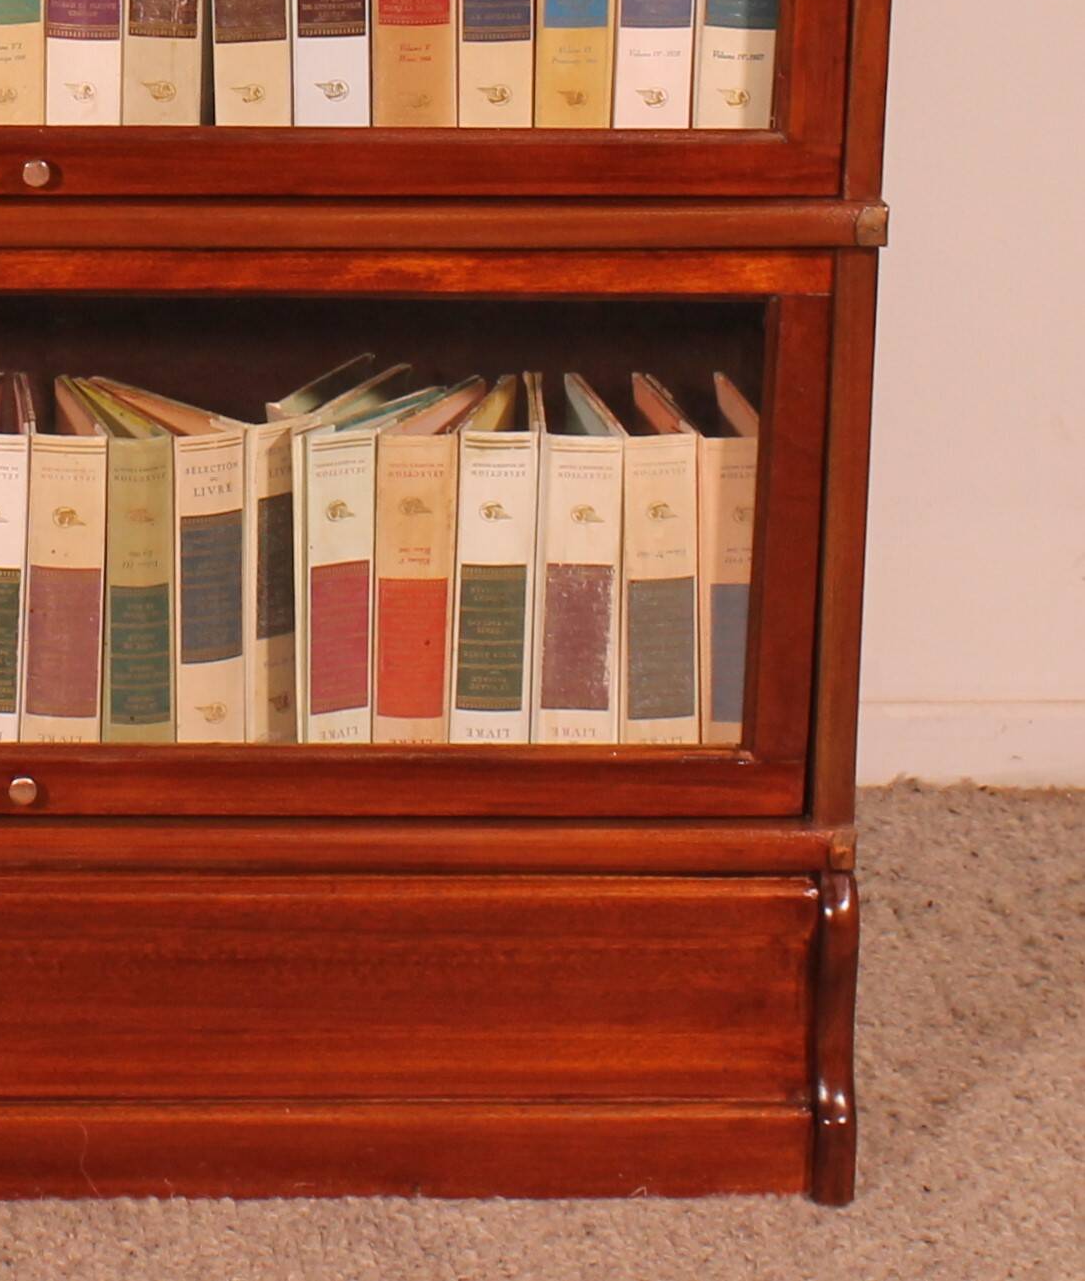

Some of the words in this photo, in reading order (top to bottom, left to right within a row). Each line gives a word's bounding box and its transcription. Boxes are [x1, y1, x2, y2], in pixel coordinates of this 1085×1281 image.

[713, 49, 735, 60] Volume
[185, 461, 239, 476] SÉLECTION
[193, 481, 233, 497] LIVRE
[318, 726, 359, 740] LIVRE
[466, 727, 510, 739] LIVRE
[552, 726, 596, 739] LIVRE
